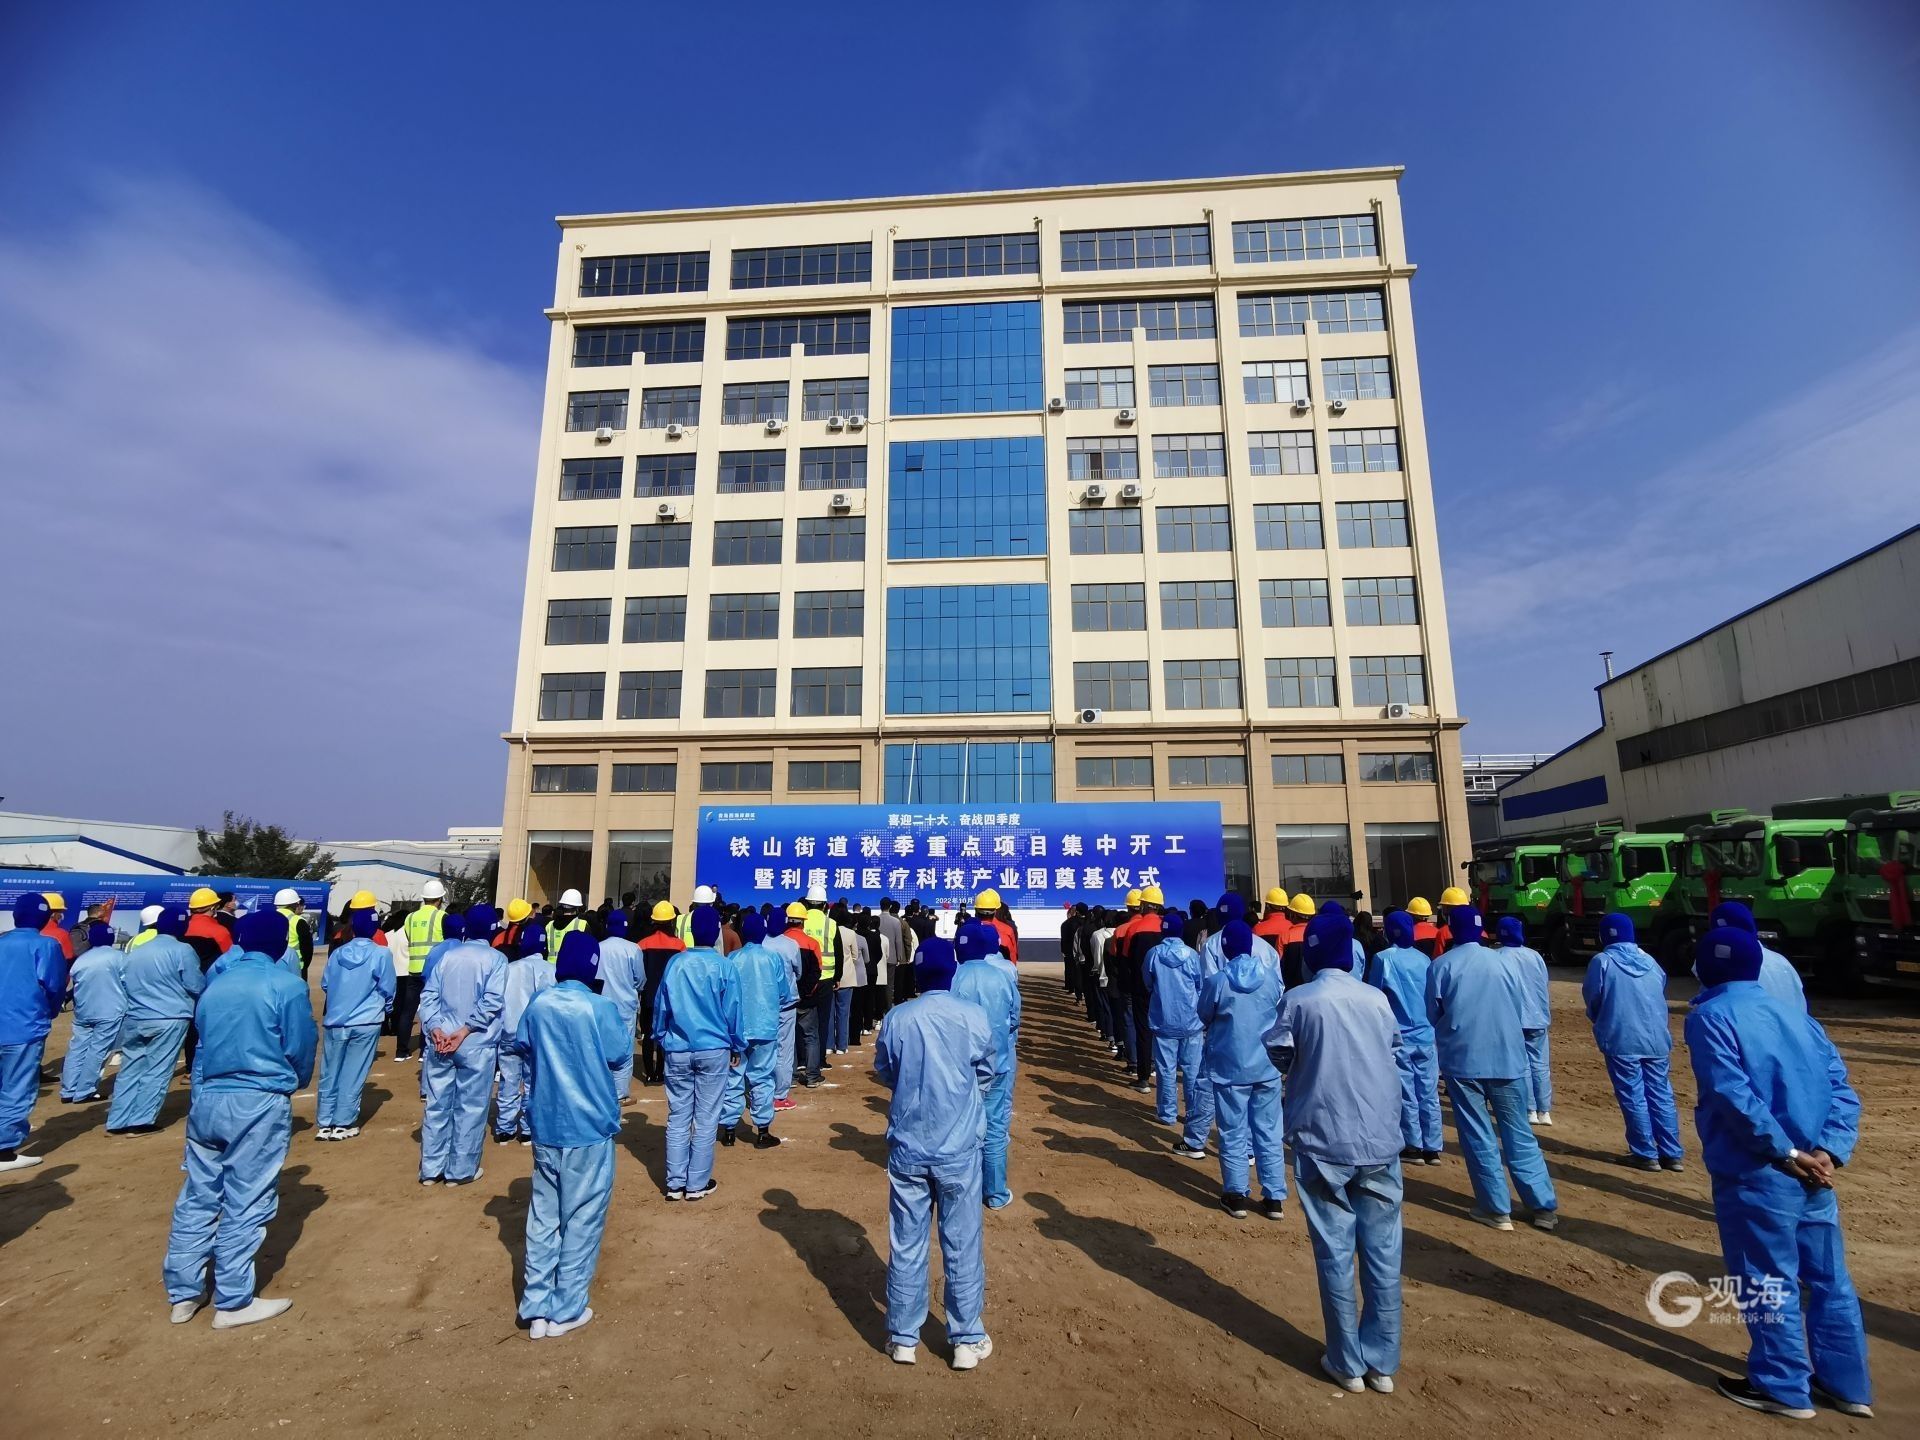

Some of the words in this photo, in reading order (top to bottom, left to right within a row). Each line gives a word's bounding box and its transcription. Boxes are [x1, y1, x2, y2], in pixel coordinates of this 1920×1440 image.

[888, 813, 948, 826] 喜迎二十大
[959, 813, 1021, 826] 奋战四季度
[730, 833, 1186, 858] 铁山街道秋季重点项目集中开工
[754, 866, 1161, 890] 暨利康源医疗科技产业园奠基仪式
